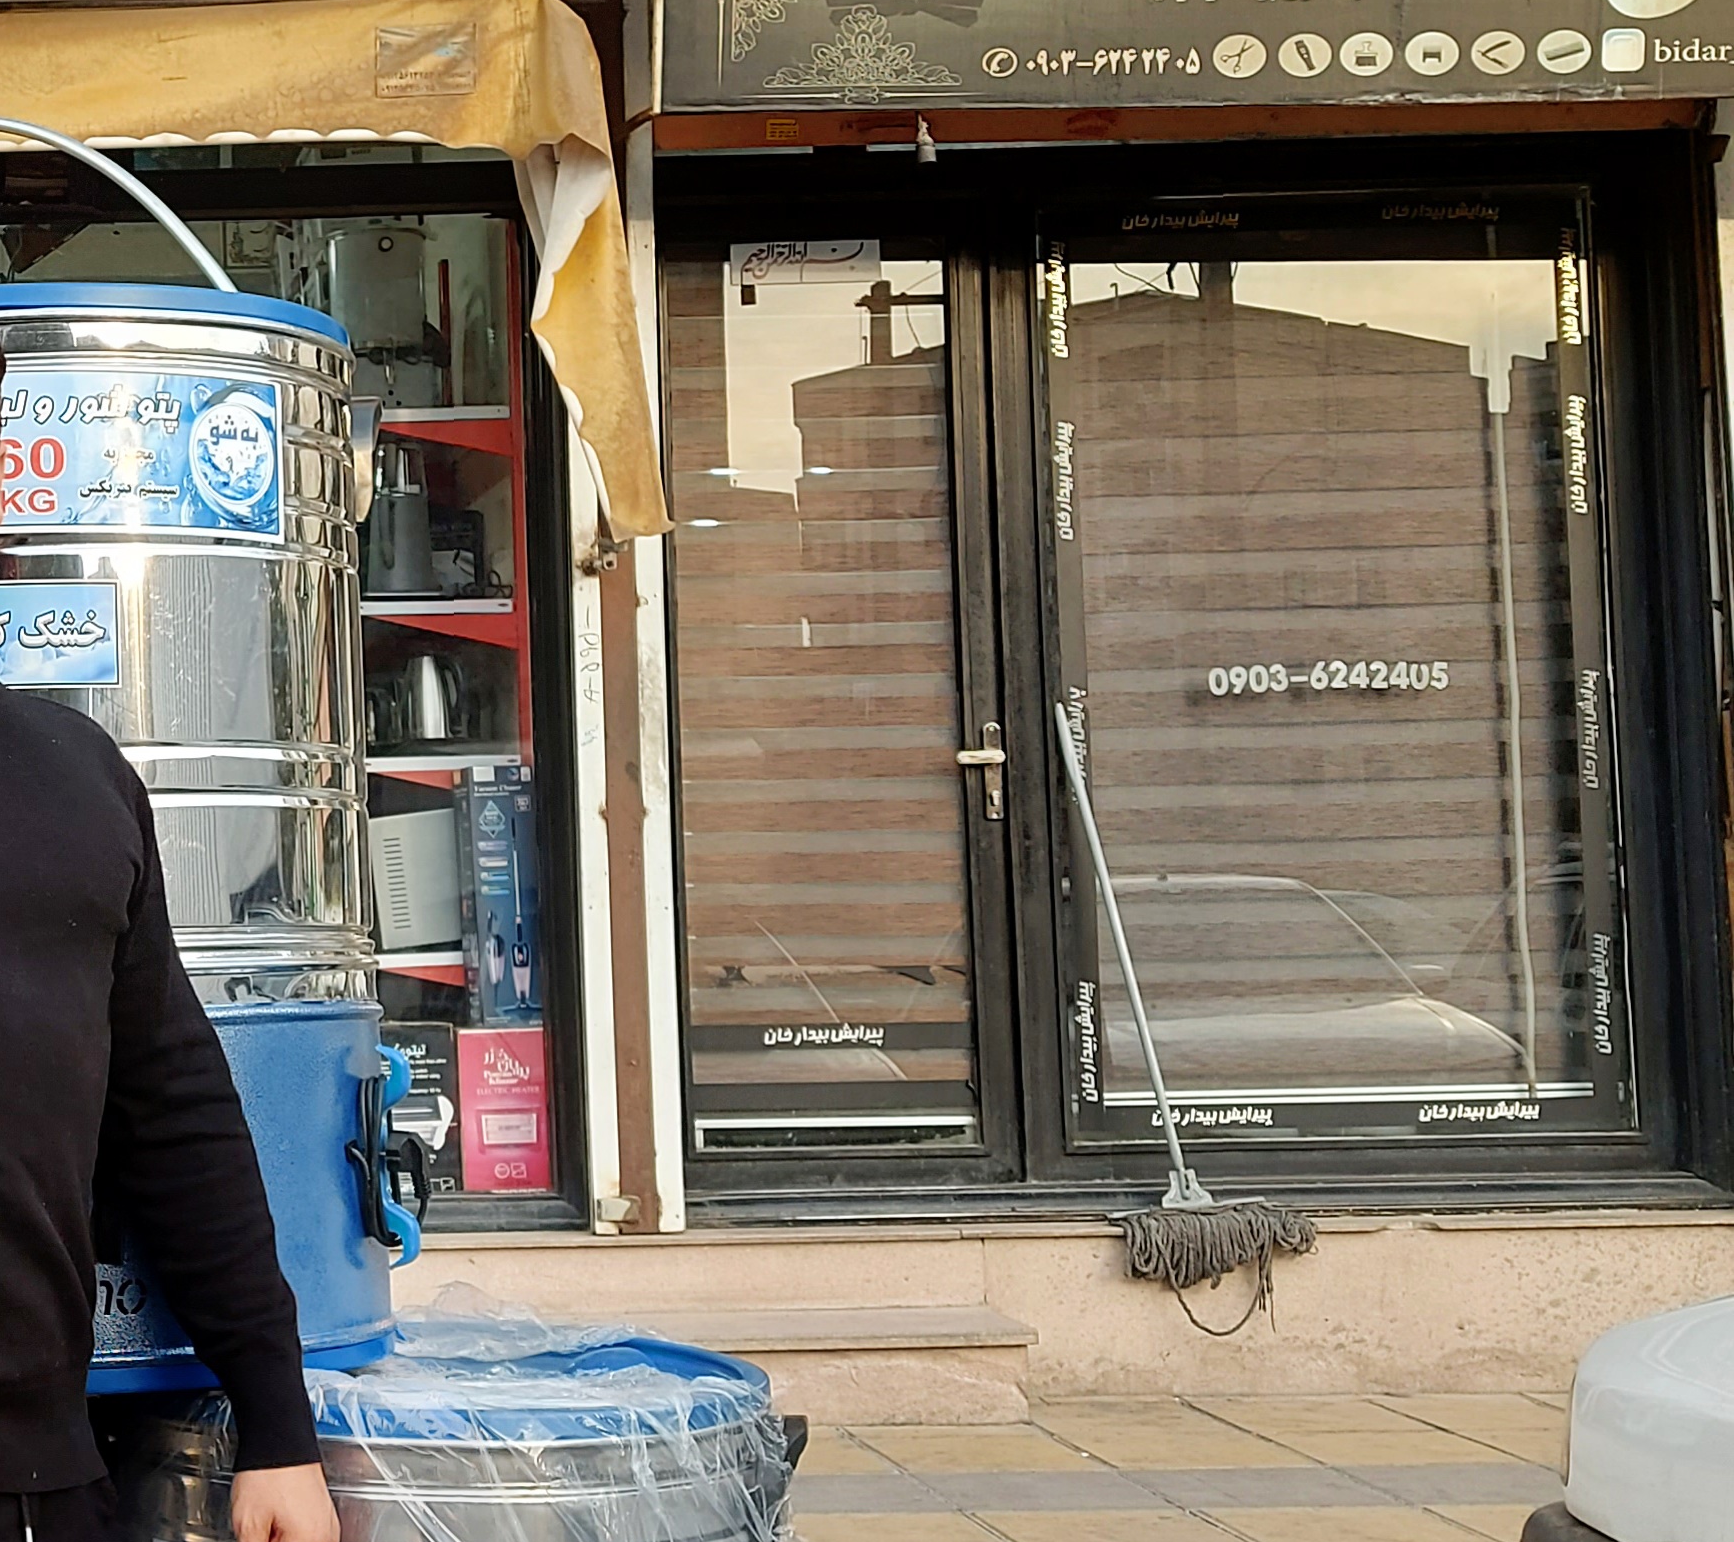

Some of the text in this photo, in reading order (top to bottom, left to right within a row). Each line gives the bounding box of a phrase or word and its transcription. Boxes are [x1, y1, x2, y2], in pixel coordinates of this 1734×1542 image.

[33, 393, 54, 425] و
[0, 437, 65, 480] 60
[0, 488, 58, 514] KG
[16, 608, 107, 652] خشک
